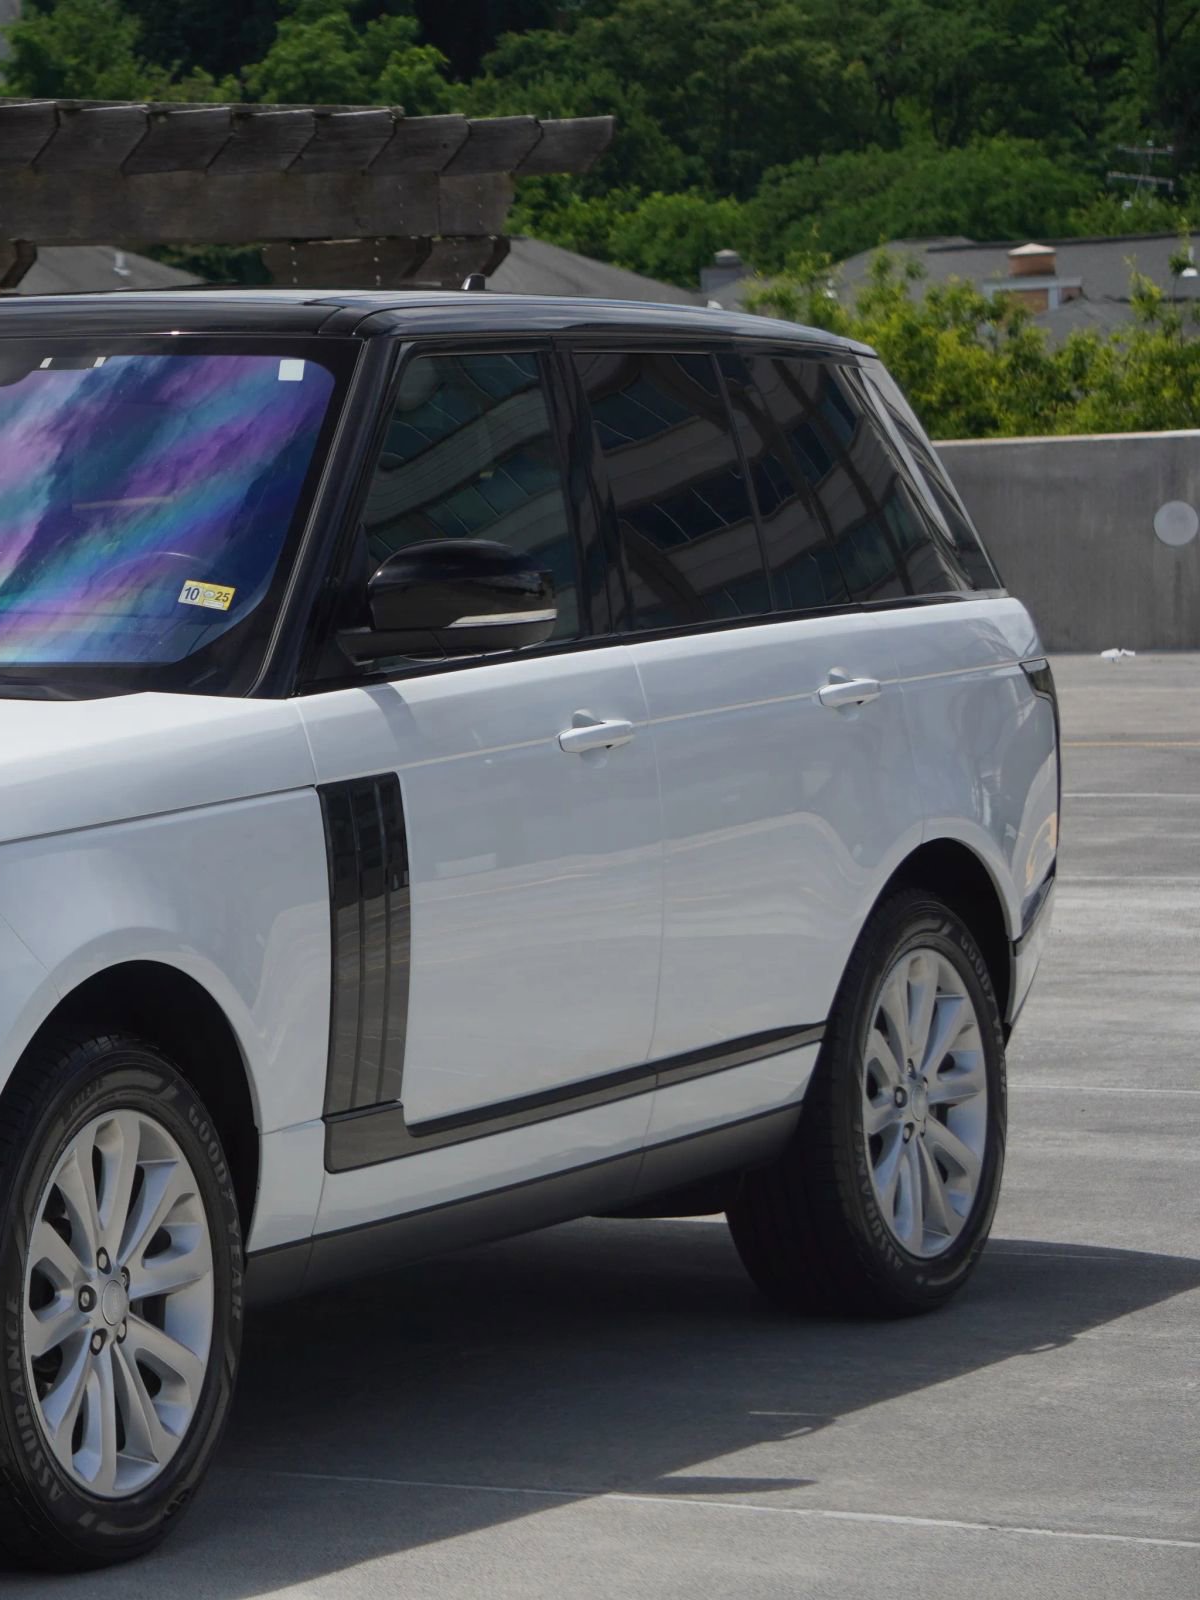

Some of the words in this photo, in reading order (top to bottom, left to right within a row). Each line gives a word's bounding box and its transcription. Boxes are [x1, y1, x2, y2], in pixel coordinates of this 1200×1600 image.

[184, 586, 200, 601] 10
[214, 591, 230, 603] 25
[5, 1291, 65, 1503] ASSURANCE
